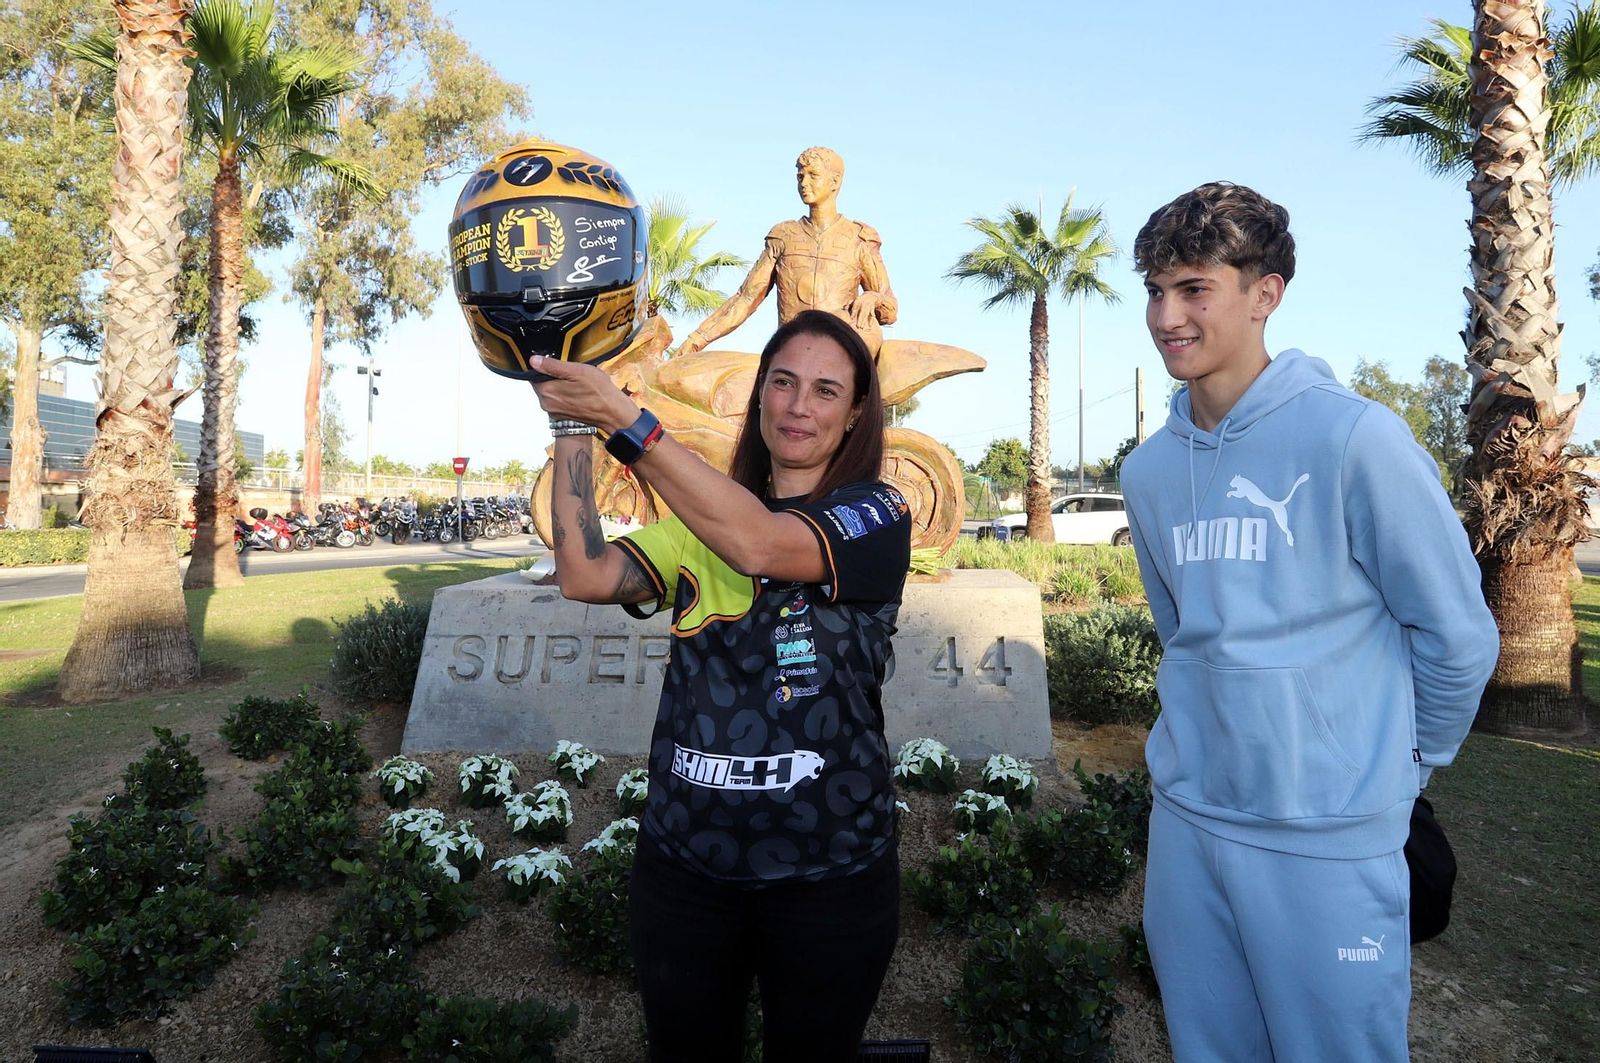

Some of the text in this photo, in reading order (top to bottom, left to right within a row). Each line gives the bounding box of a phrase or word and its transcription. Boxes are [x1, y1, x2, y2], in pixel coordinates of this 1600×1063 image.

[575, 217, 626, 233] Siempre
[579, 235, 618, 250] Contigo
[1172, 516, 1268, 566] PUMA
[926, 636, 1013, 687] 44
[1337, 947, 1379, 962] PUMA
